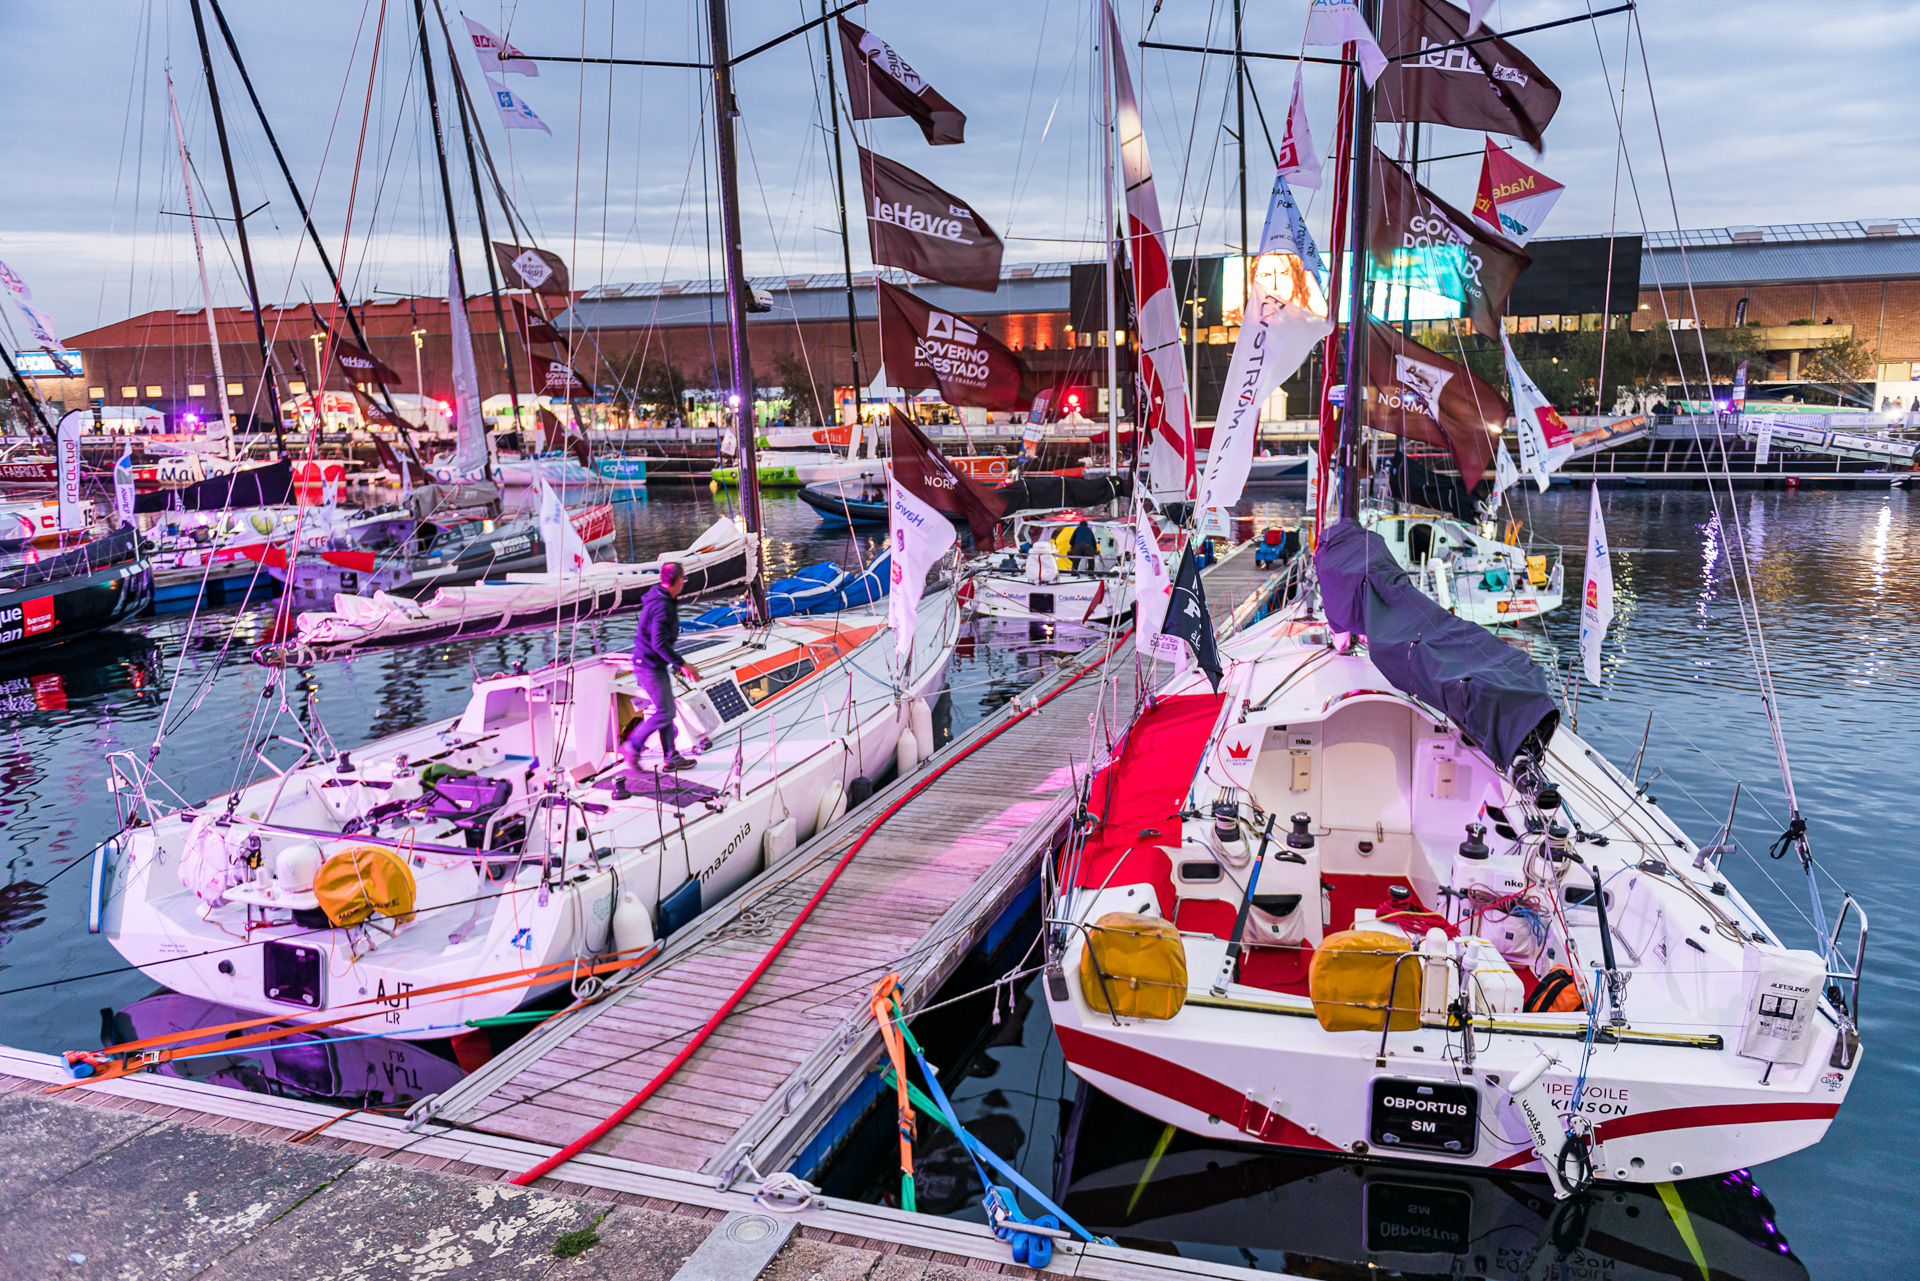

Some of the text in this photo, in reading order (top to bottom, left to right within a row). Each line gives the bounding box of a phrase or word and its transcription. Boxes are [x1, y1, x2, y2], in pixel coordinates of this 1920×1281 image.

[875, 196, 963, 239] leHavre
[932, 357, 990, 380] ESTADO
[1755, 405, 1800, 413] IMOCA
[4, 465, 47, 478] FABRIQUE
[62, 439, 77, 504] creactuel
[603, 464, 639, 473] CORUM
[1504, 879, 1524, 888] nke
[376, 978, 413, 1010] AJT
[1580, 1086, 1628, 1101] VOILE
[1383, 1096, 1468, 1116] OBPORTUS
[1411, 1119, 1436, 1133] SM
[1521, 1099, 1547, 1147] watt&sea
